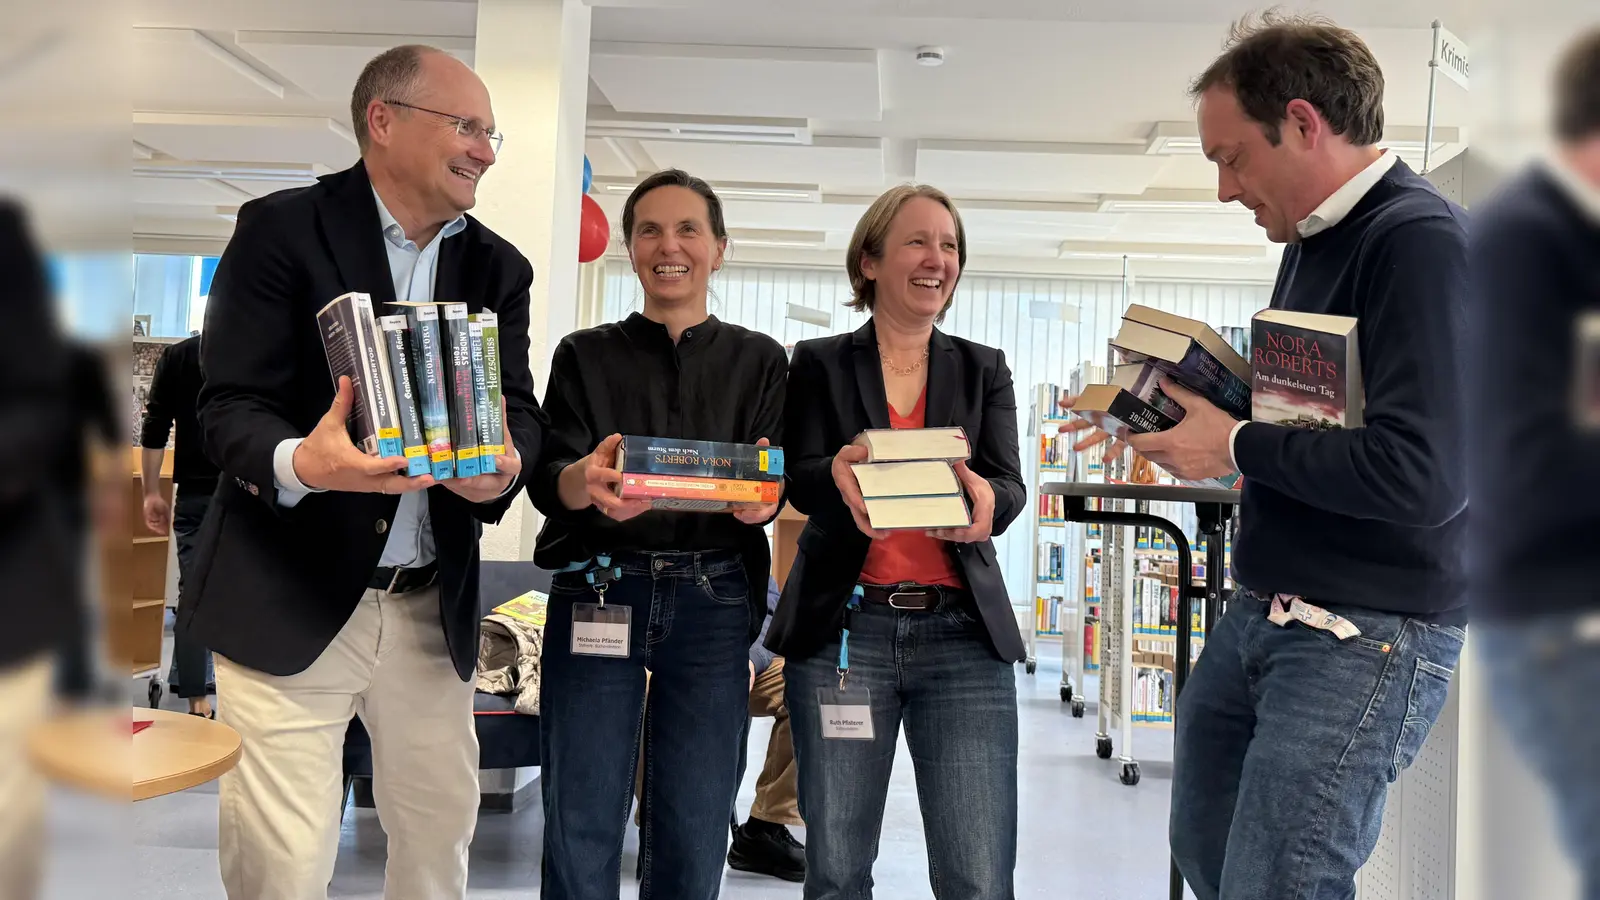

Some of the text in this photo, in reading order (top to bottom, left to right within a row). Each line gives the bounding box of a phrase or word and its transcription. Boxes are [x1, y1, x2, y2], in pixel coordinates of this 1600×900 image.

[459, 331, 469, 366] ANDREAS
[1264, 329, 1323, 359] NORA
[425, 351, 435, 384] NICOLA
[485, 337, 498, 389] Herzschuss
[1254, 348, 1337, 380] ROBERTS
[368, 347, 386, 416] CHAMPAGNERTOD
[402, 367, 412, 399] Gendarm
[1255, 371, 1335, 399] Am dunkelsten Tag
[1129, 411, 1161, 433] SCHWEIGE
[1141, 407, 1159, 424] STILL
[655, 454, 732, 468] NORA ROBERTS
